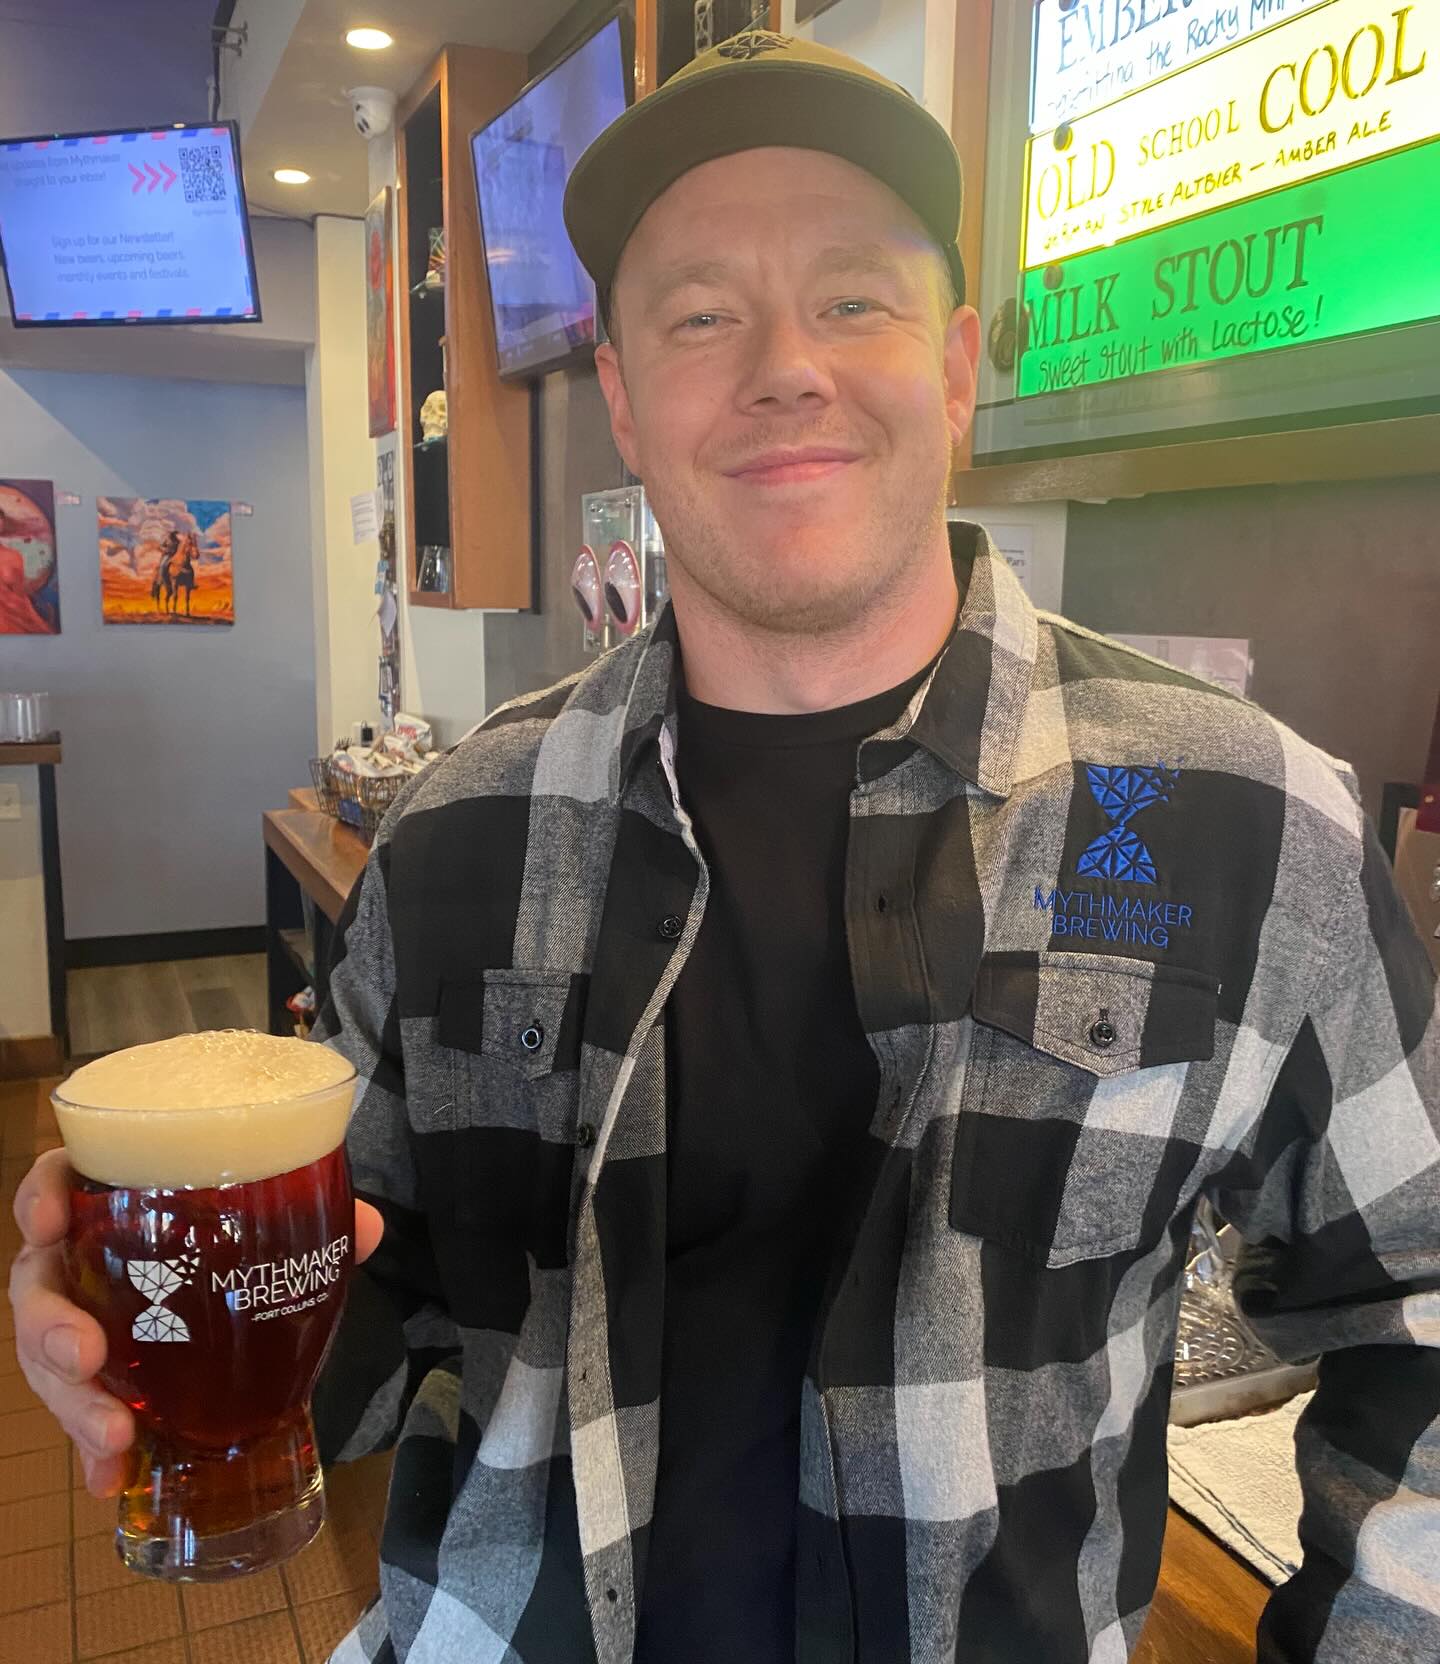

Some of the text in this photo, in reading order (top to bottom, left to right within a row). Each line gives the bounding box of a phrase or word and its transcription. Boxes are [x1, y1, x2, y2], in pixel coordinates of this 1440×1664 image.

[1147, 41, 1173, 74] the
[1187, 6, 1239, 54] Rocky
[1037, 4, 1427, 220] OLD SCHOOL COOL
[58, 175, 77, 188] your
[1119, 192, 1165, 224] STYLE
[1275, 131, 1337, 166] AMBER
[1347, 110, 1392, 144] ALE
[51, 233, 71, 250] Sign
[73, 236, 86, 248] up
[87, 234, 99, 246] for
[102, 234, 117, 246] our
[54, 254, 75, 264] New
[107, 252, 155, 265] upcoming
[57, 270, 94, 284] monthly
[130, 270, 147, 280] and
[1026, 214, 1325, 350] MILK STOUT
[1162, 327, 1198, 365] with
[1033, 885, 1192, 927] MYTHMAKER
[1053, 914, 1169, 949] BREWING
[211, 1234, 348, 1293] MYTHMAKER
[234, 1261, 340, 1311] BREWING
